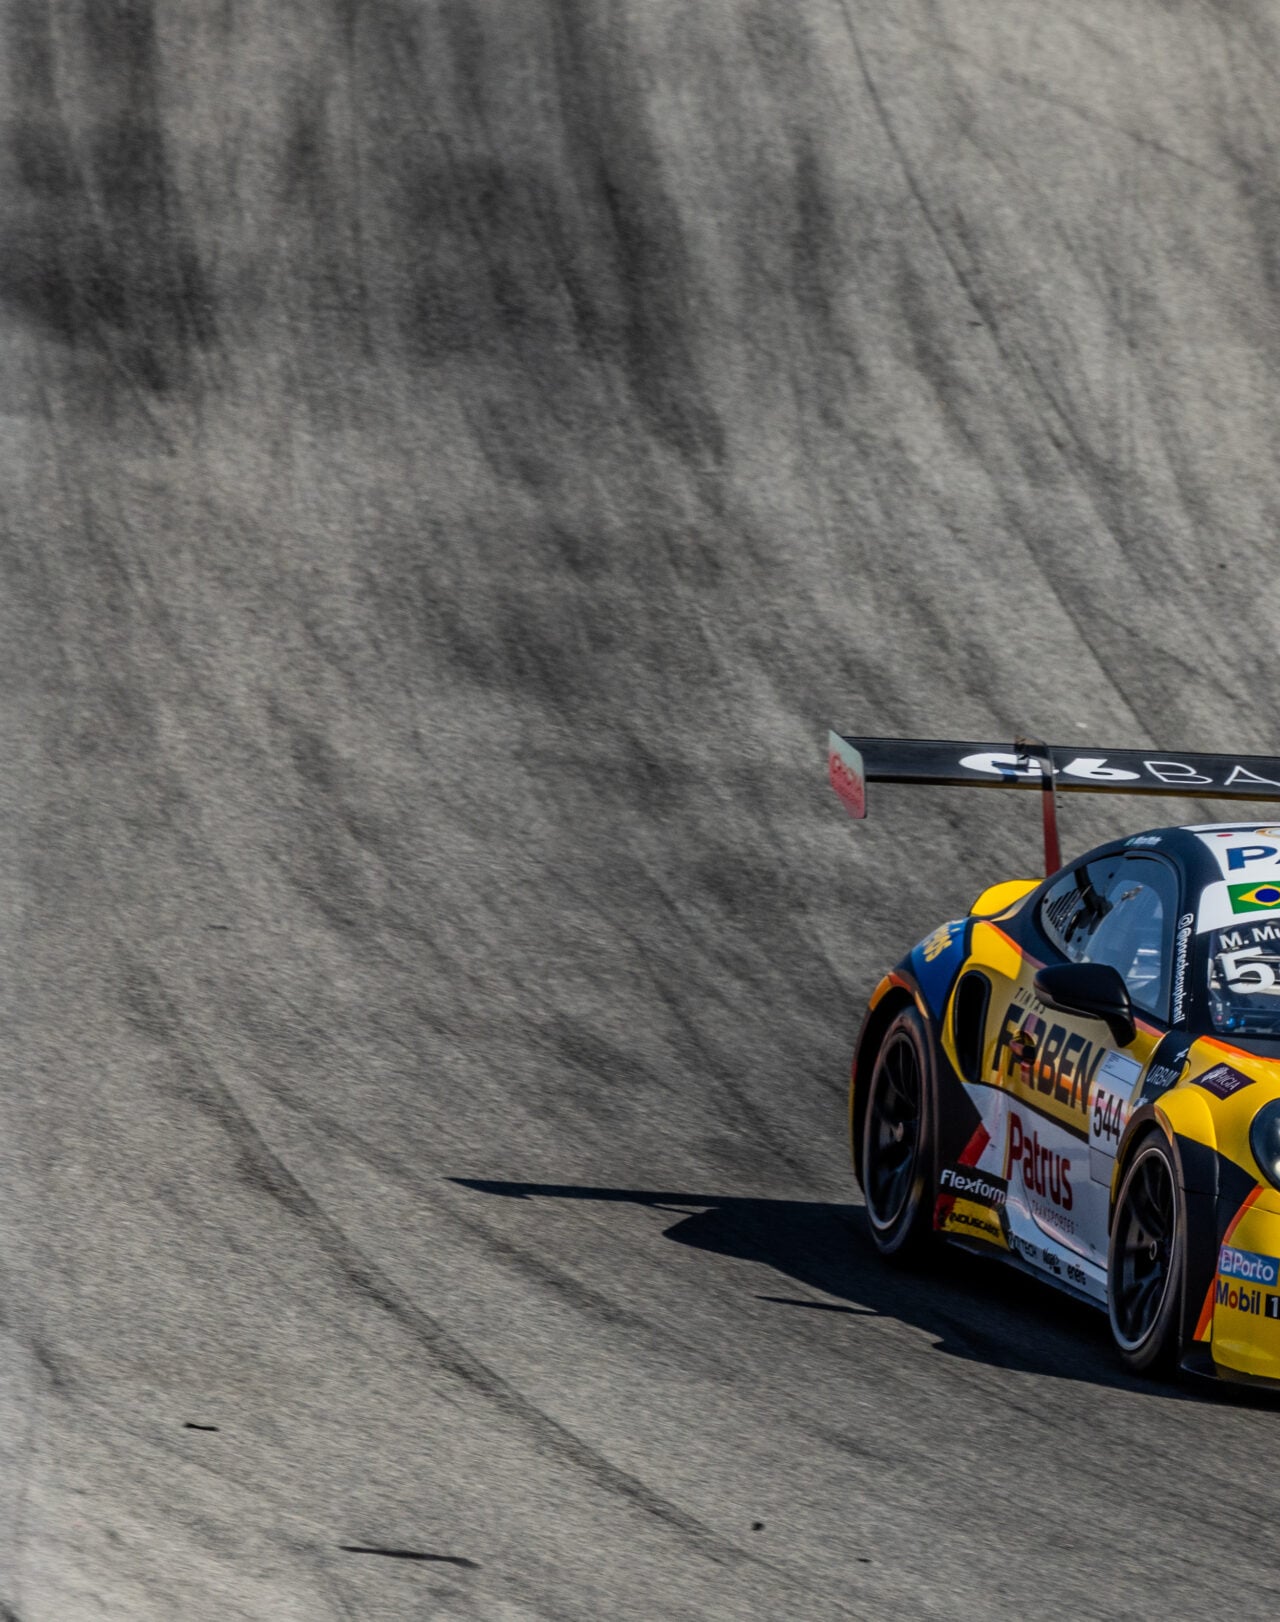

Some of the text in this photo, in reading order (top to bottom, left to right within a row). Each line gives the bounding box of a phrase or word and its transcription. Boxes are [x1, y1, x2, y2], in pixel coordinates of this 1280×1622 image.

[1219, 933, 1249, 950] M.
[1092, 1089, 1124, 1146] 544
[1006, 1110, 1073, 1212] Patrus
[940, 1169, 1007, 1205] Flexform
[1232, 1251, 1275, 1282] Porto
[1215, 1280, 1261, 1316] Mobil
